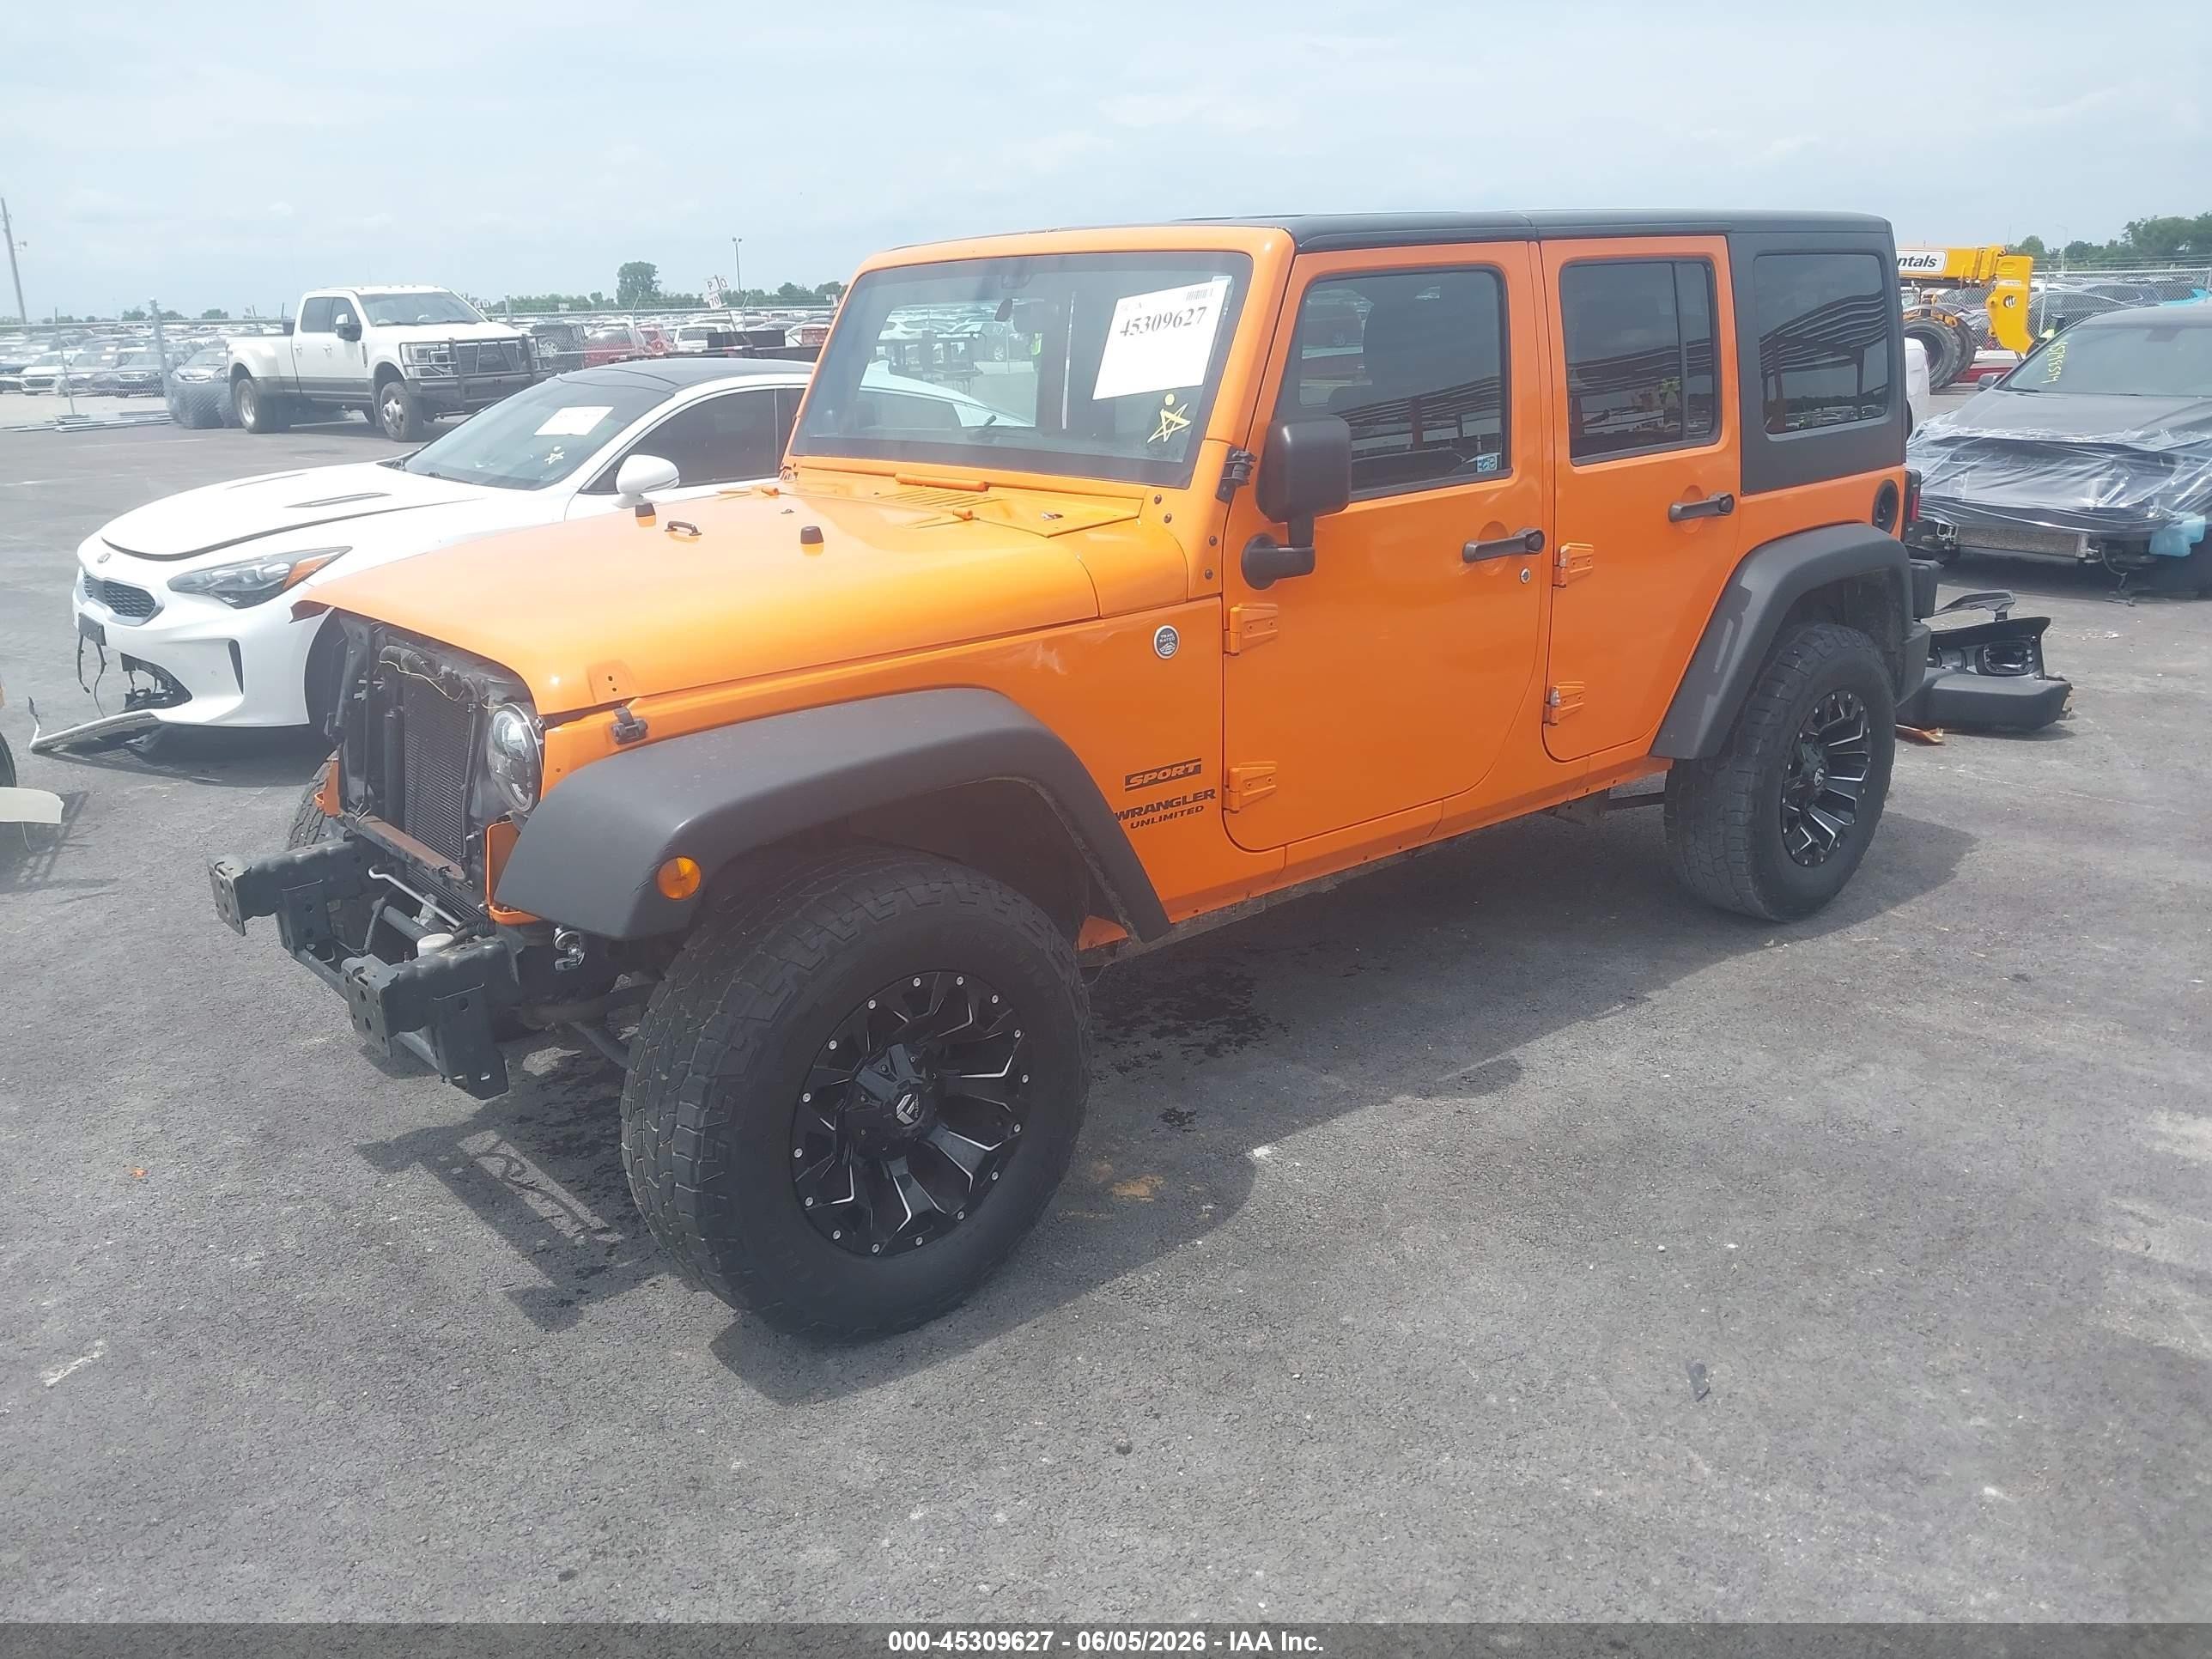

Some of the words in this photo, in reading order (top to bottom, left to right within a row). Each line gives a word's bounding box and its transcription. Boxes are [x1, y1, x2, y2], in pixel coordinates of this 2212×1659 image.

[708, 281, 713, 290] P
[1120, 307, 1207, 337] 45309627
[1126, 762, 1201, 787] SPORT
[1115, 789, 1216, 821] WRANGLER
[1130, 805, 1204, 829] UNLIMITED
